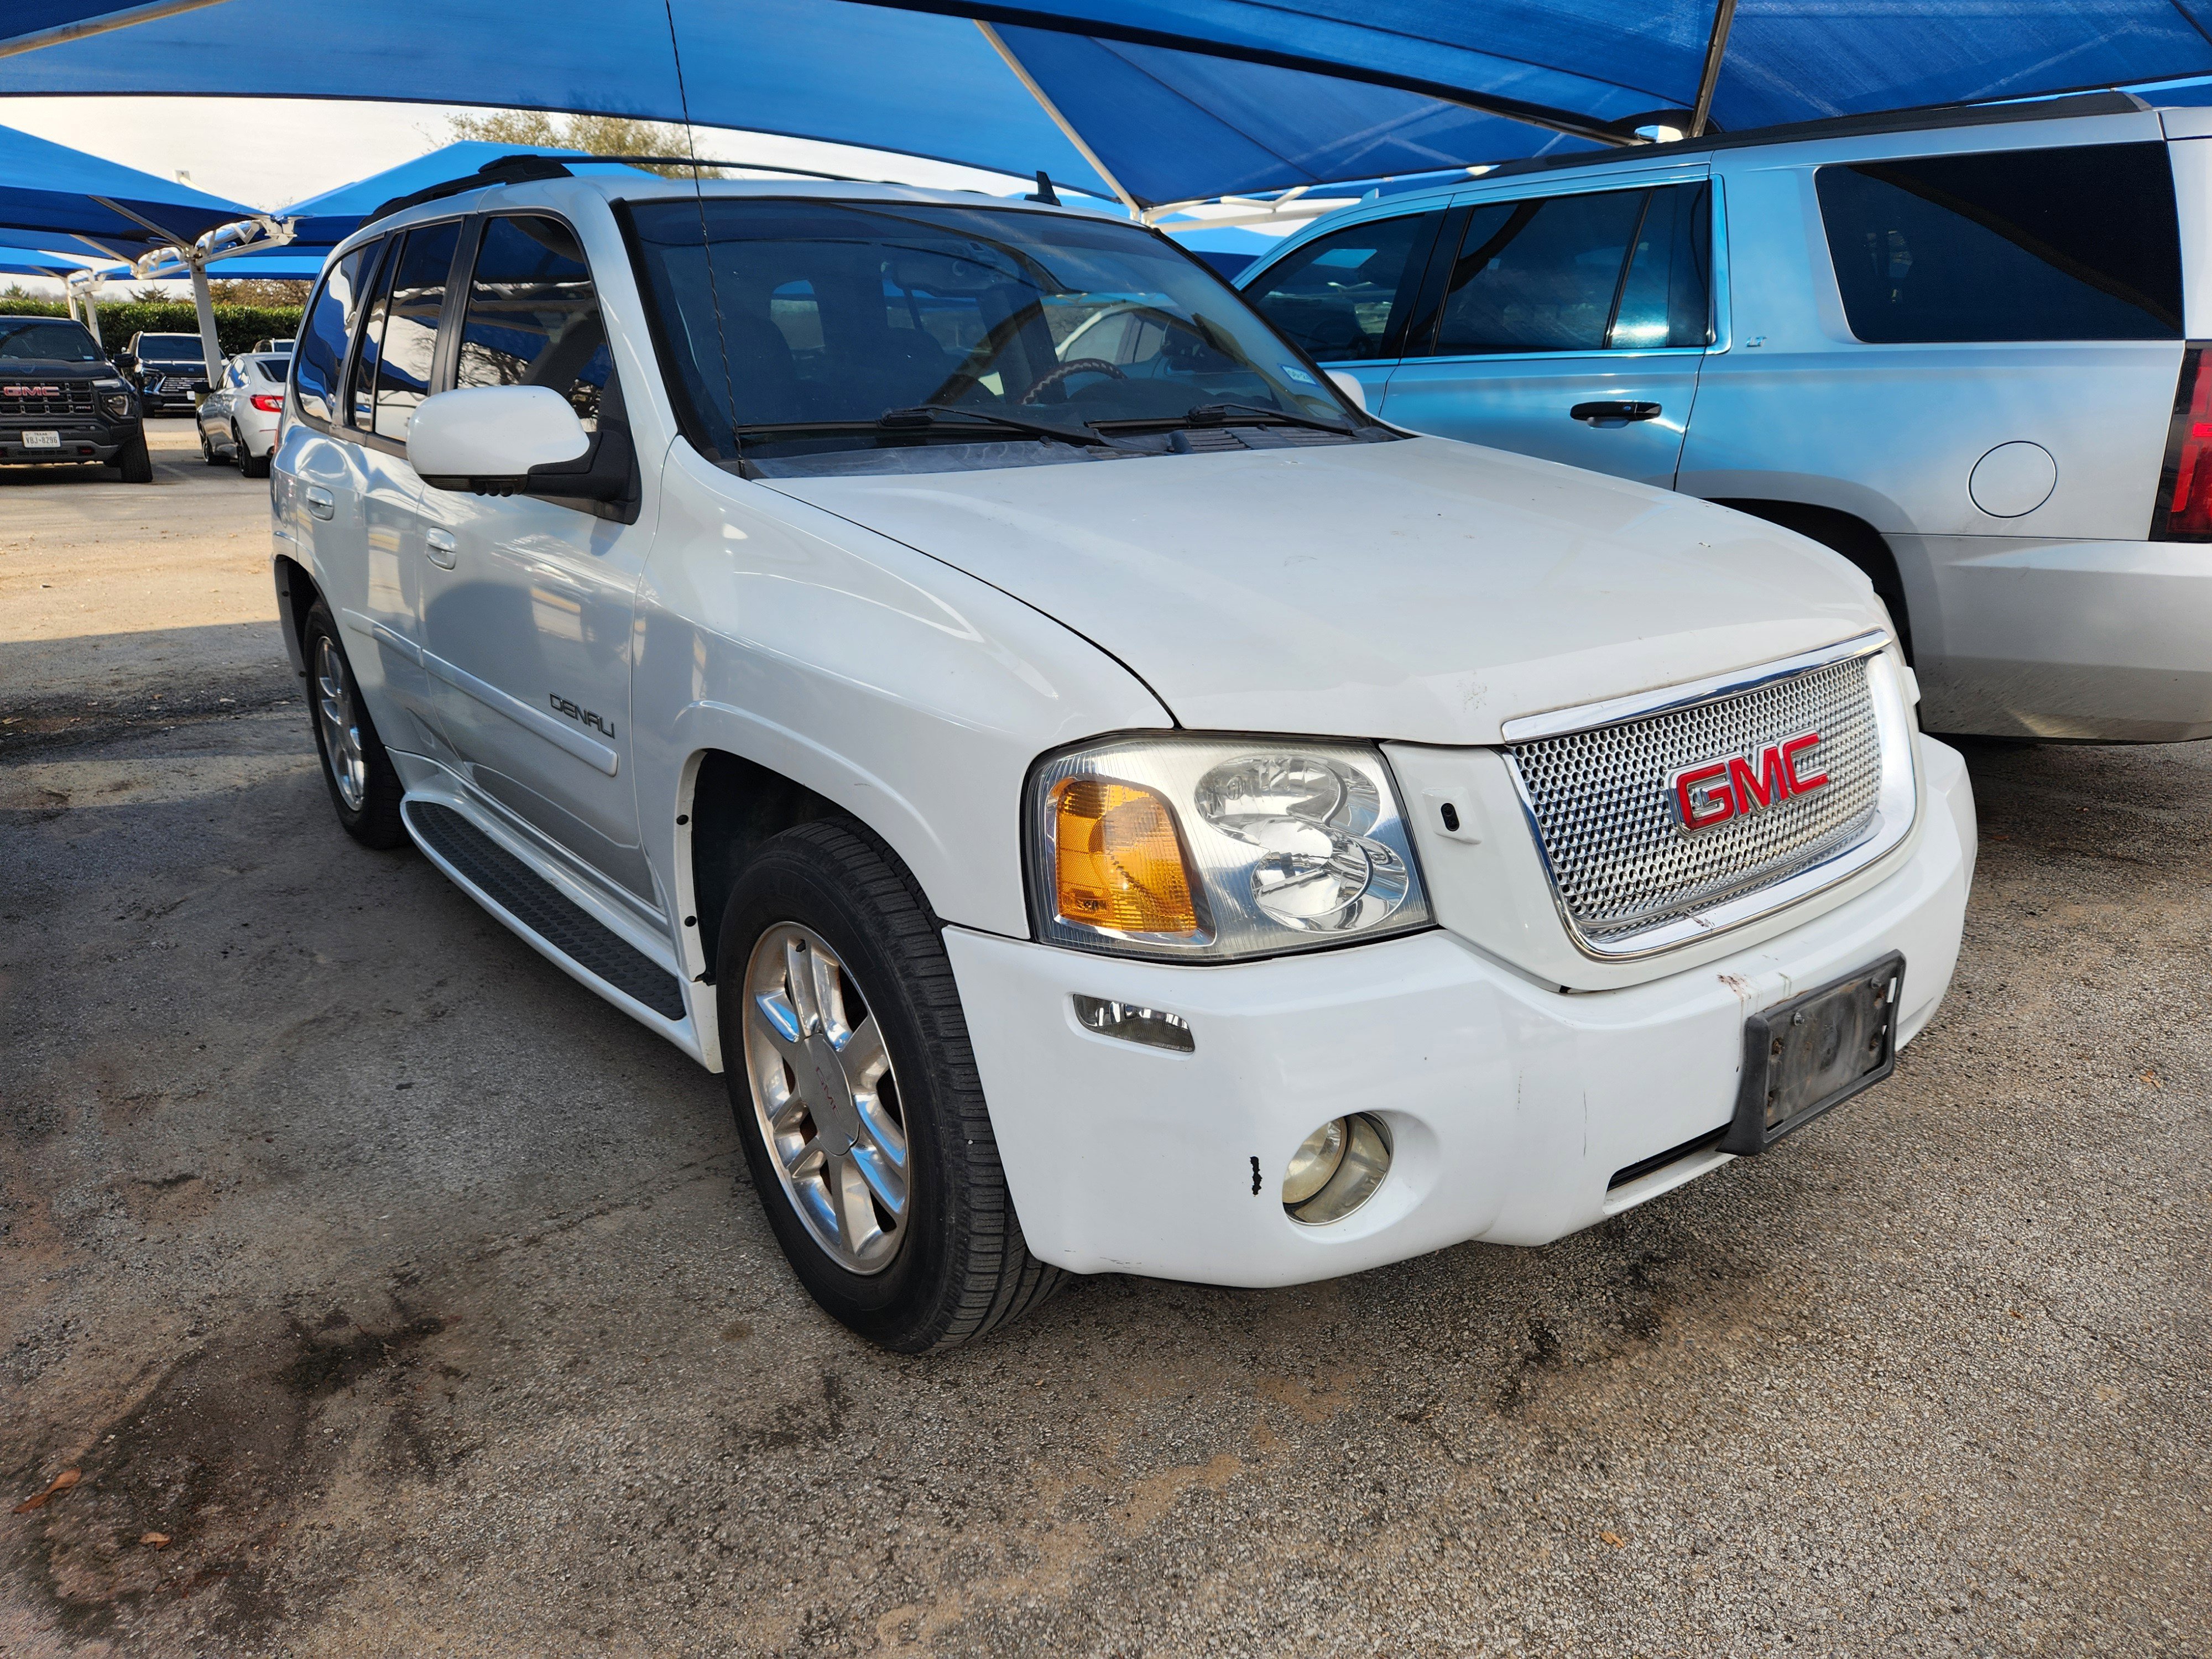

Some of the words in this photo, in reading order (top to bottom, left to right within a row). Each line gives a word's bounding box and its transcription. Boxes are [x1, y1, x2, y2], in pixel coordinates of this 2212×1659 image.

[4, 387, 60, 396] GMC
[549, 692, 615, 739] DENALI
[1665, 727, 1829, 836] GMC
